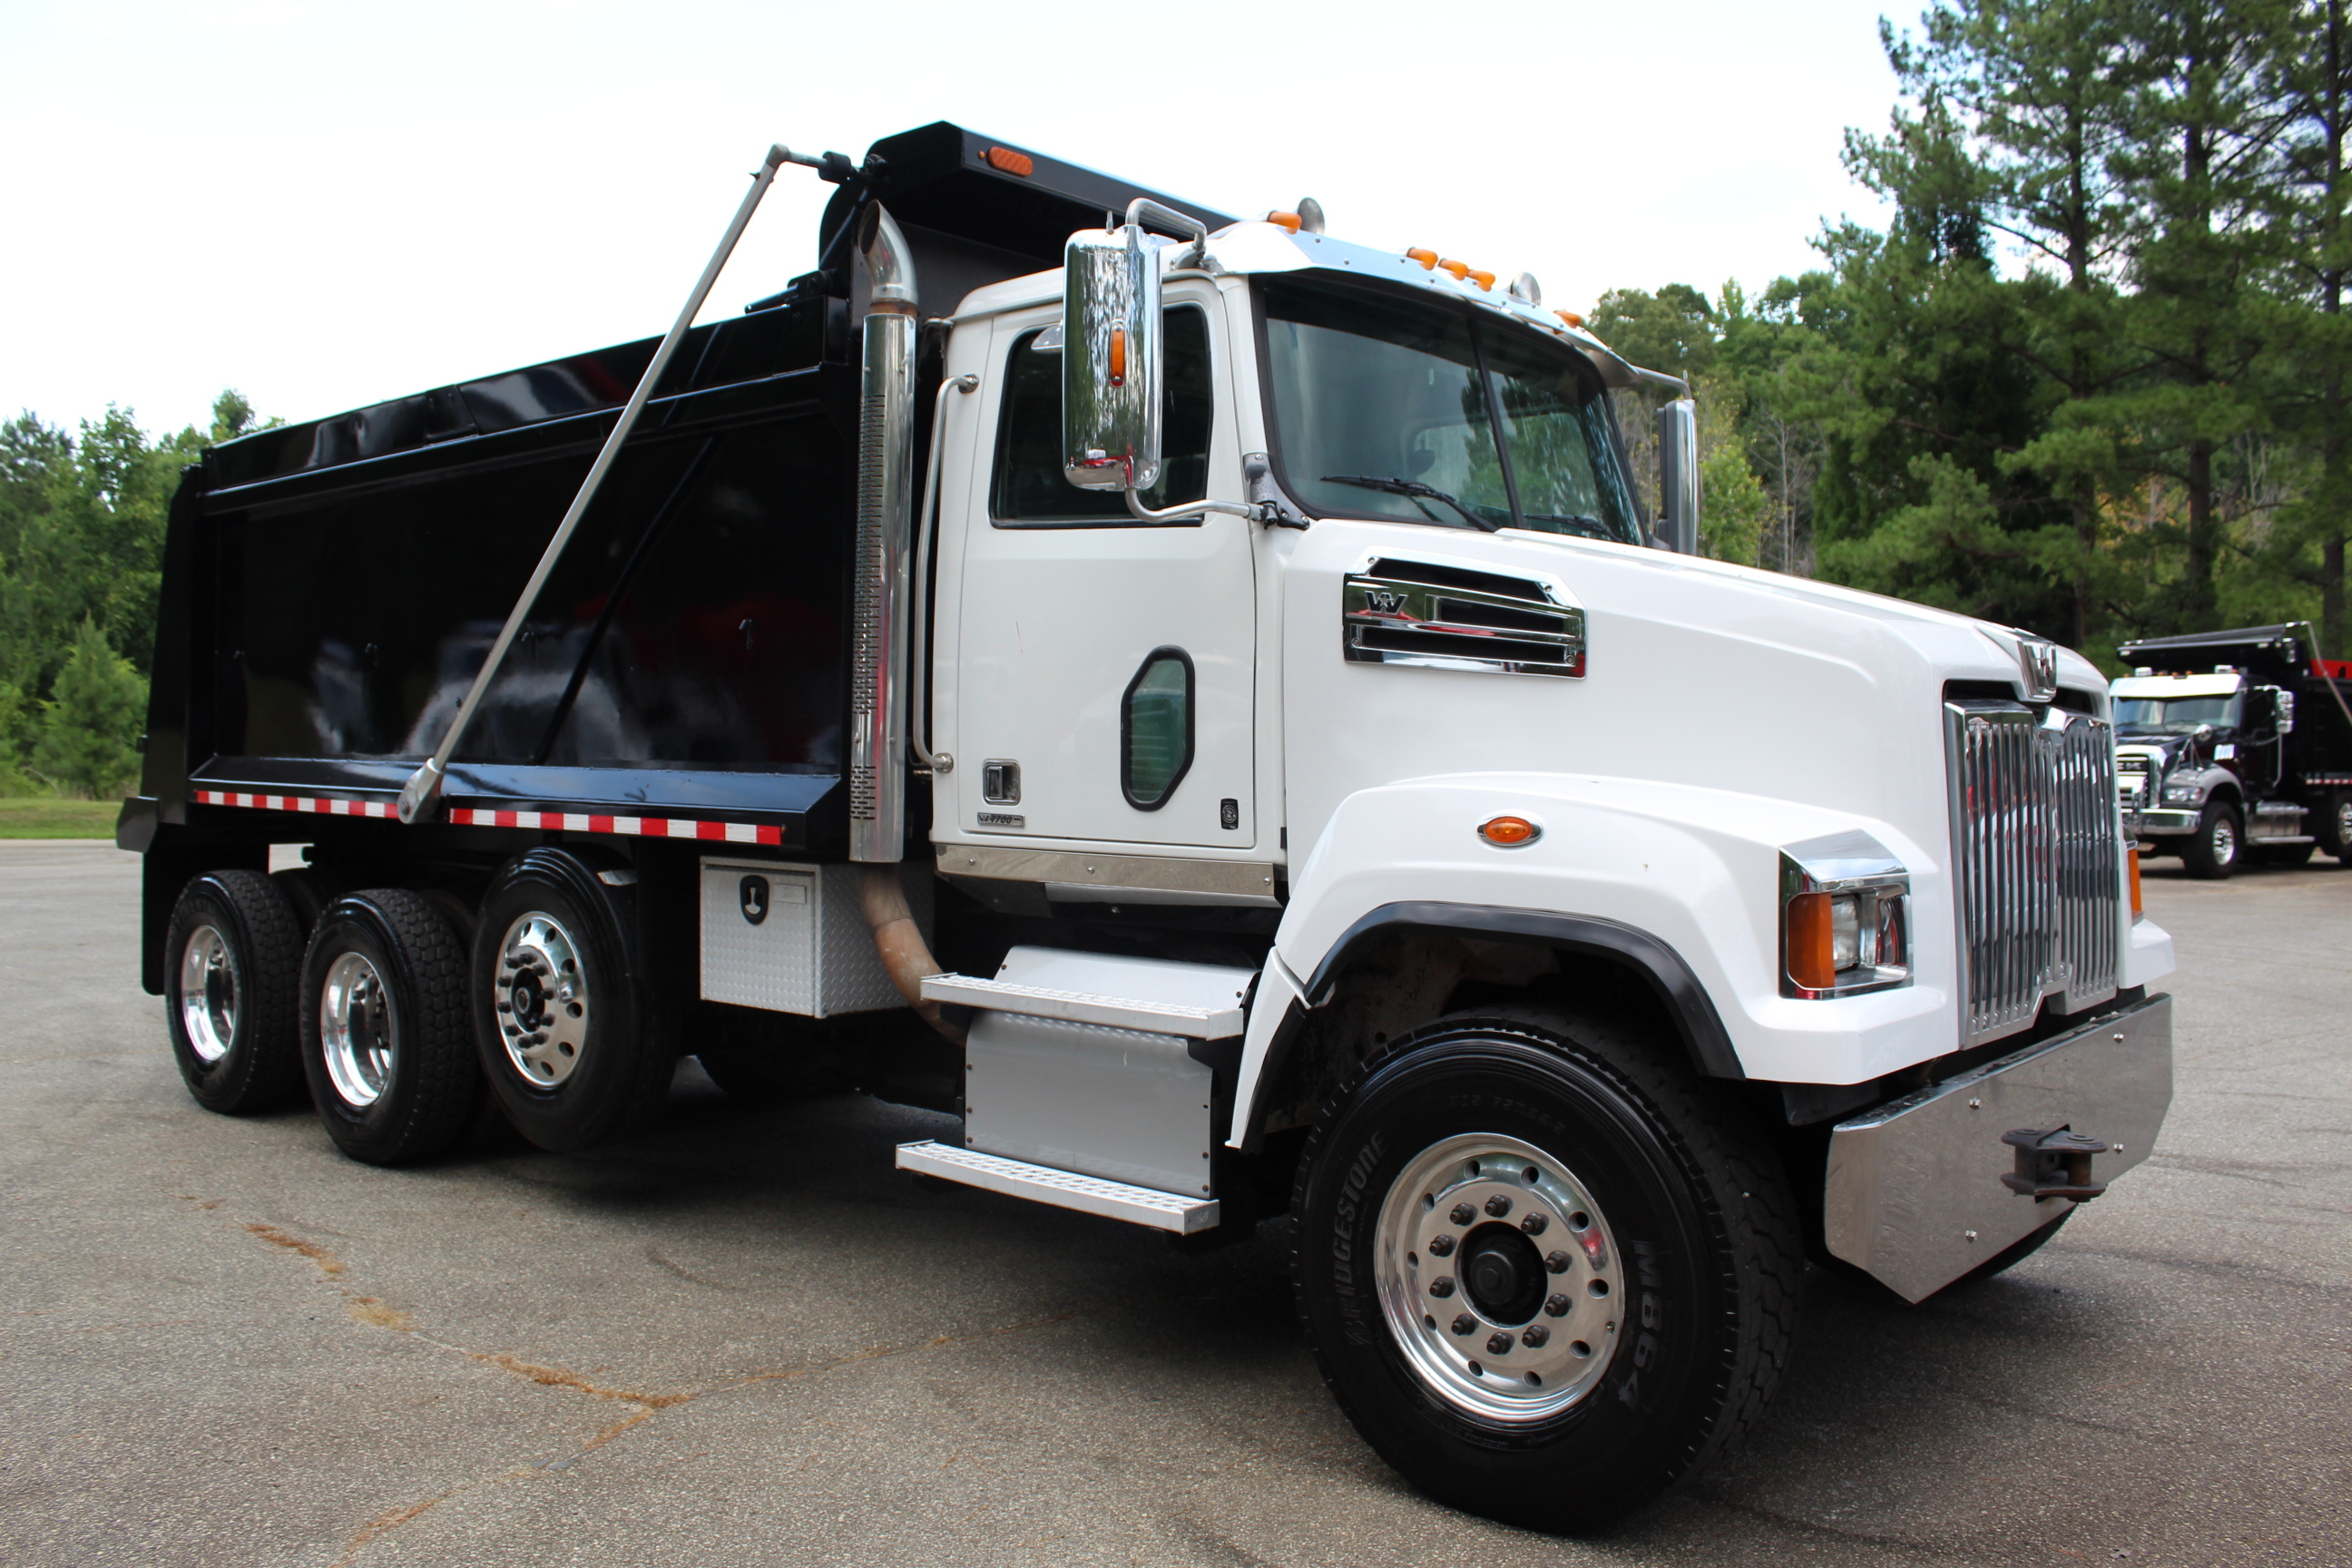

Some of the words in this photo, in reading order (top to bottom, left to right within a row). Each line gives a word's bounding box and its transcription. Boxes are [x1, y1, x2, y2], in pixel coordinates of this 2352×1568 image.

[990, 816, 1013, 824] 4700
[1333, 1131, 1388, 1345] BRIDGESTONE
[1618, 1240, 1662, 1410] M864
